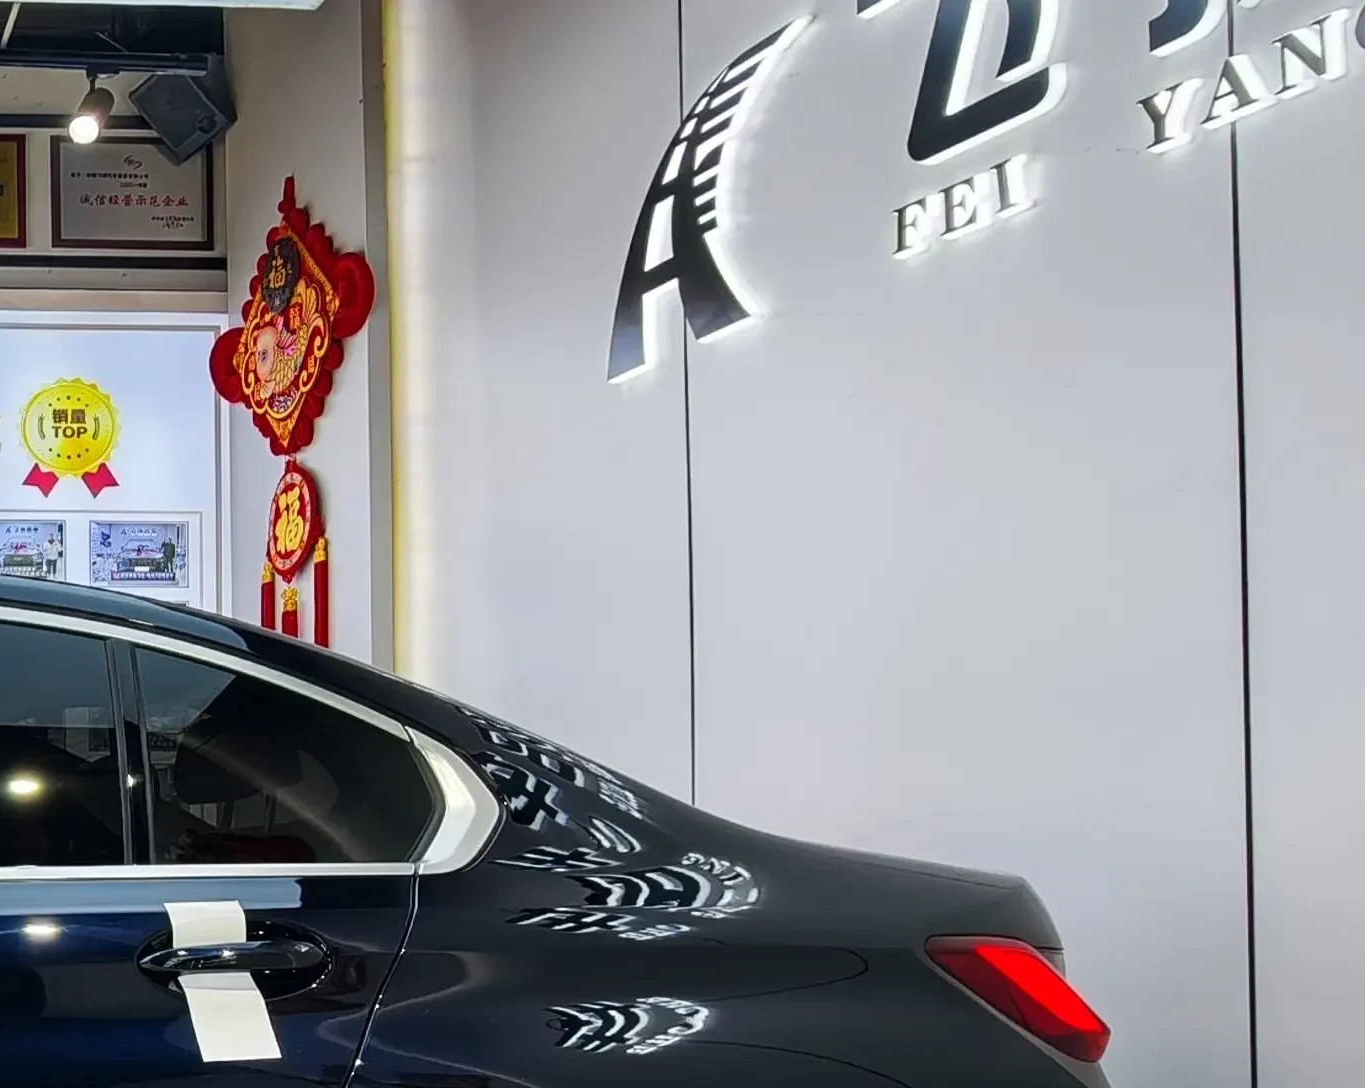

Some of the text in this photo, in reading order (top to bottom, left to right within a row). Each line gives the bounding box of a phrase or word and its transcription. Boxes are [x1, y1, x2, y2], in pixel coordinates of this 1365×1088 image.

[1137, 5, 1365, 154] YAN
[79, 193, 190, 208] 诚信经营示范企业
[891, 152, 1037, 259] FEI
[52, 426, 88, 439] TOP
[53, 408, 87, 425] 销量
[275, 486, 304, 555] 福
